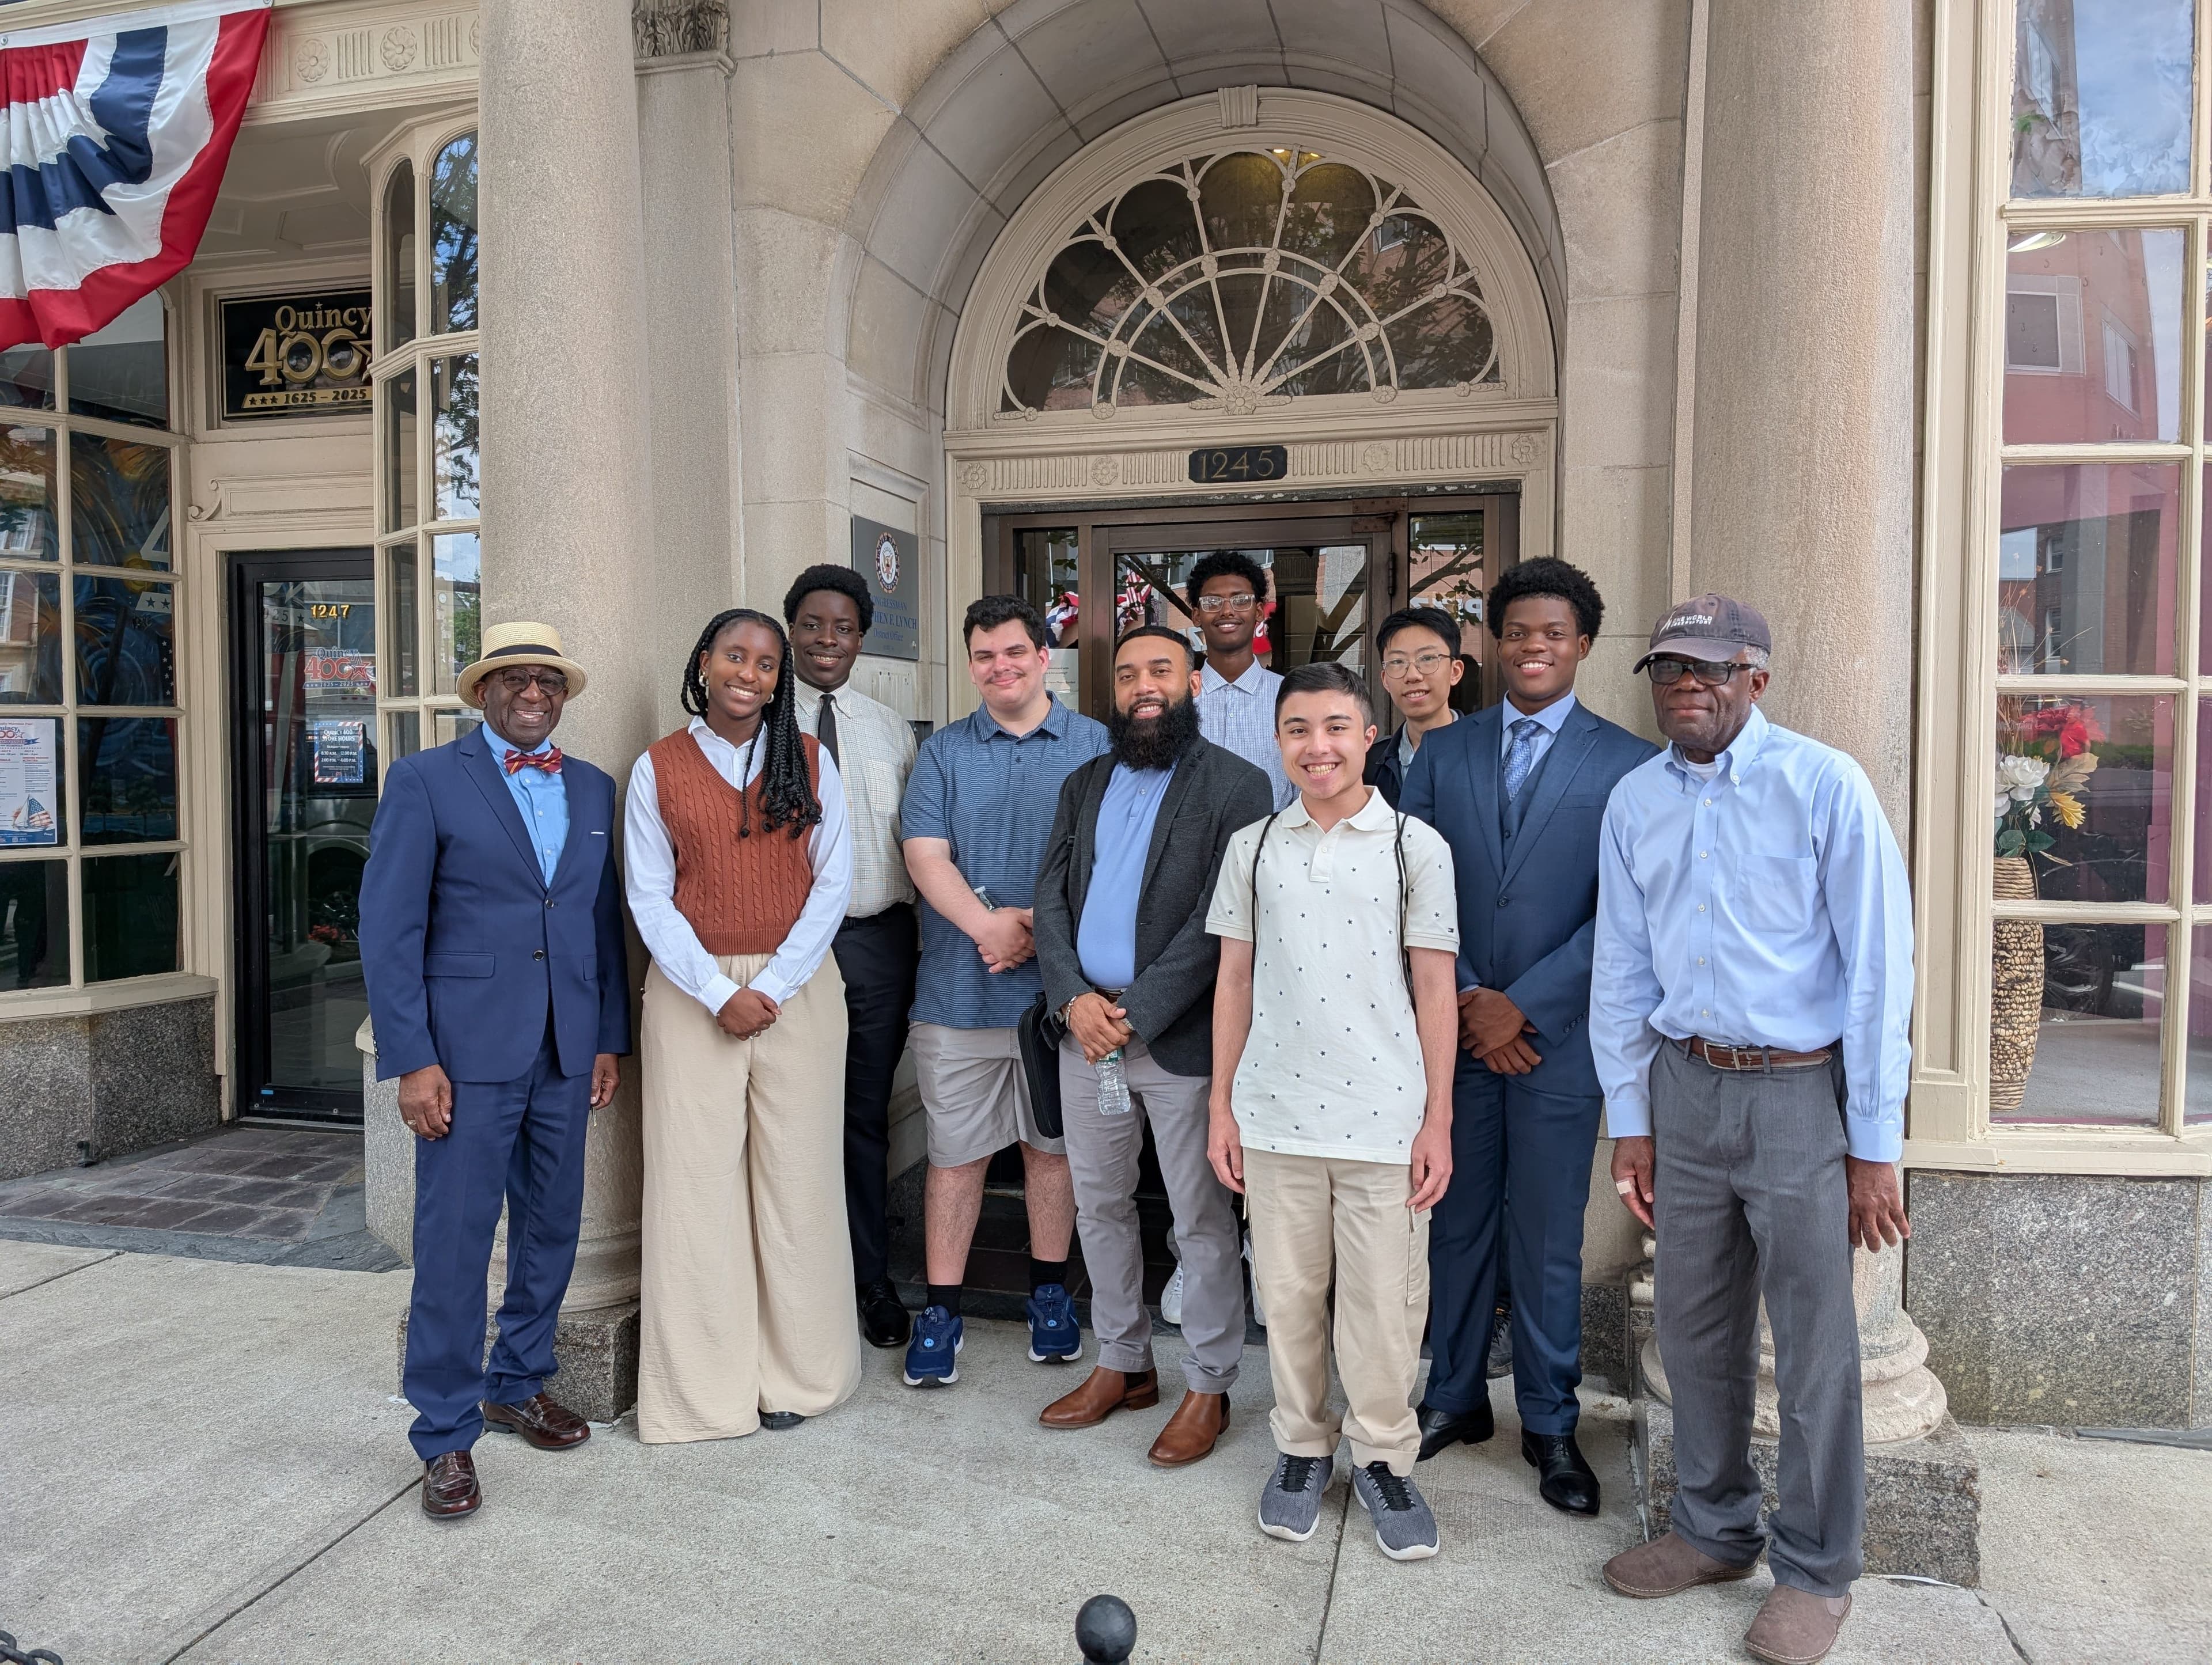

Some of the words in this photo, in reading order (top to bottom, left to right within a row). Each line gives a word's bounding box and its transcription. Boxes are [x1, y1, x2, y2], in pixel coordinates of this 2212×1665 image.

[275, 302, 372, 337] Quincy
[245, 328, 363, 385] 400
[285, 392, 316, 404] 1625
[332, 389, 367, 401] 2025
[1200, 450, 1274, 479] 1245
[871, 594, 907, 610] ONGRESSMAN
[311, 605, 350, 619] 1247
[896, 615, 917, 629] LYNCH
[317, 647, 358, 661] Quincy
[304, 656, 353, 680] 400
